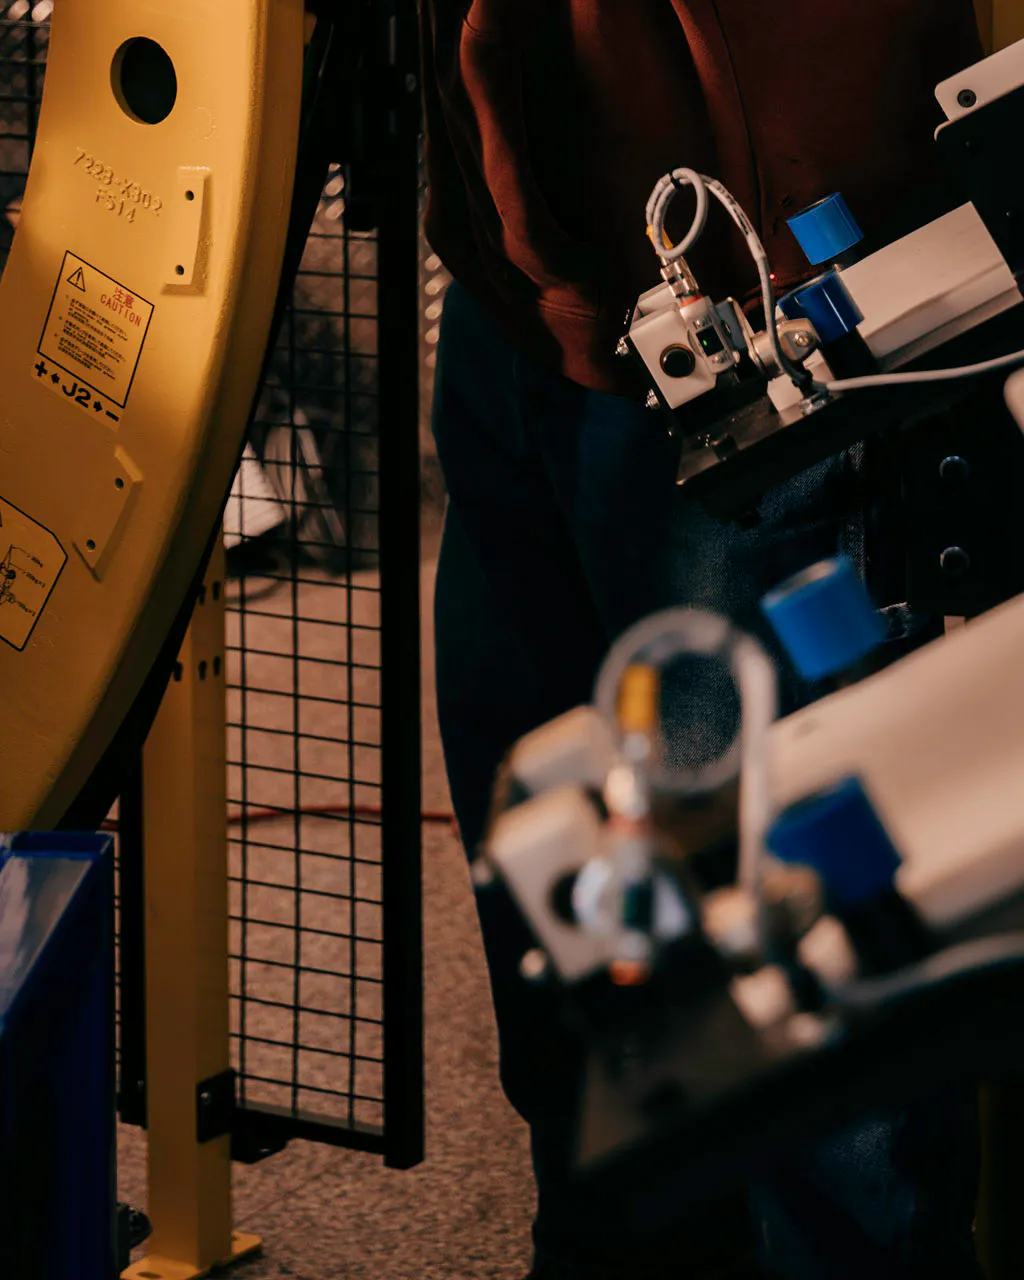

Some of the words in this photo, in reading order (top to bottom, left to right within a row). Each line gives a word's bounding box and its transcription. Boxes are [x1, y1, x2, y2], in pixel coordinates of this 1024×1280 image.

[100, 294, 142, 327] CAUTION
[112, 287, 135, 310] 注意
[62, 382, 91, 408] J2
